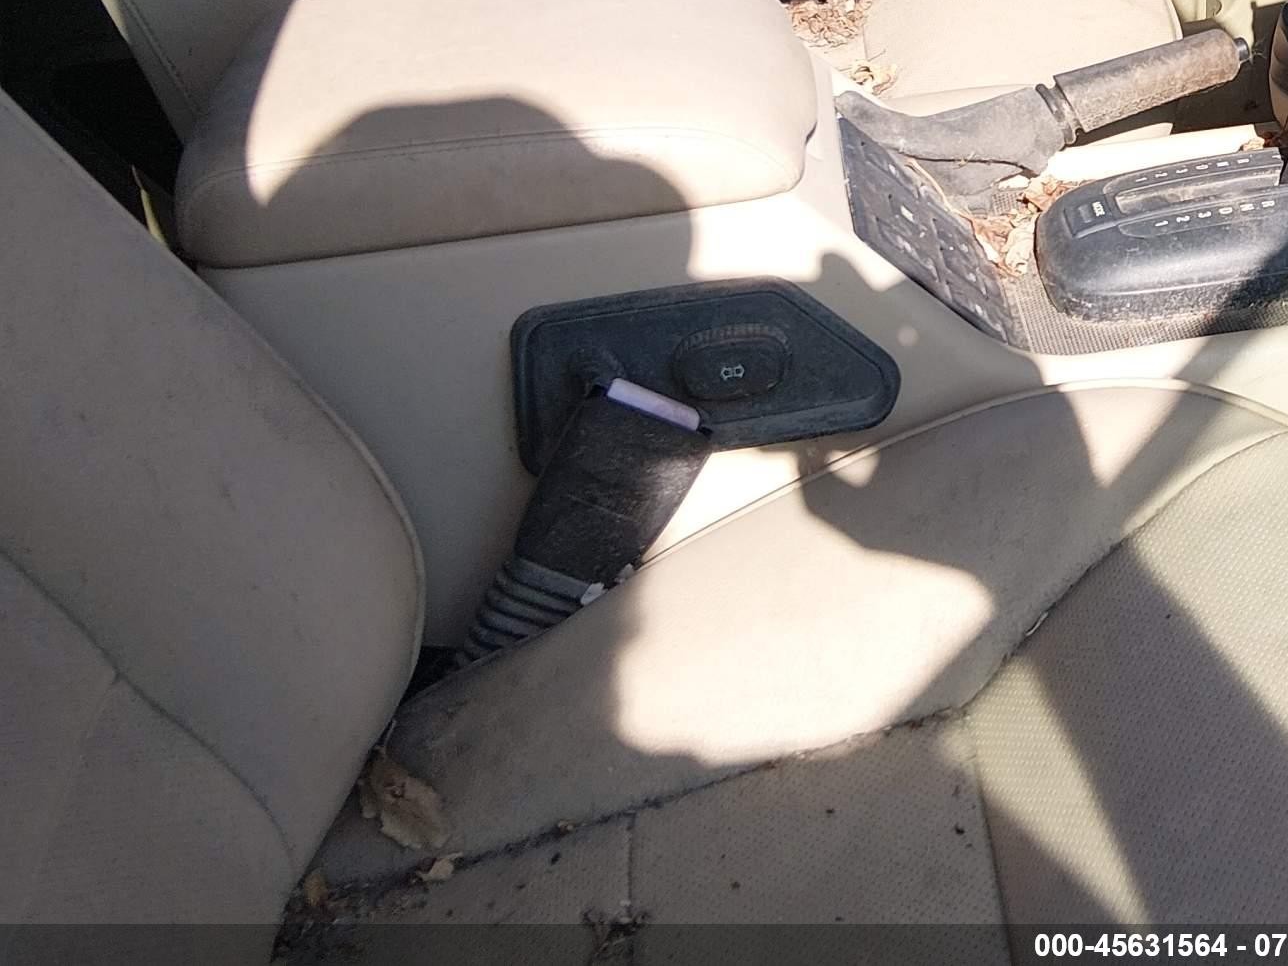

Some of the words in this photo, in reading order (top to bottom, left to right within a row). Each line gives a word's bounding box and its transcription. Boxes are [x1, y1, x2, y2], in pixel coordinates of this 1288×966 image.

[1239, 203, 1255, 212] N
[1261, 200, 1276, 208] R
[1197, 210, 1212, 218] 3
[1218, 206, 1233, 215] D
[1175, 215, 1190, 223] 2
